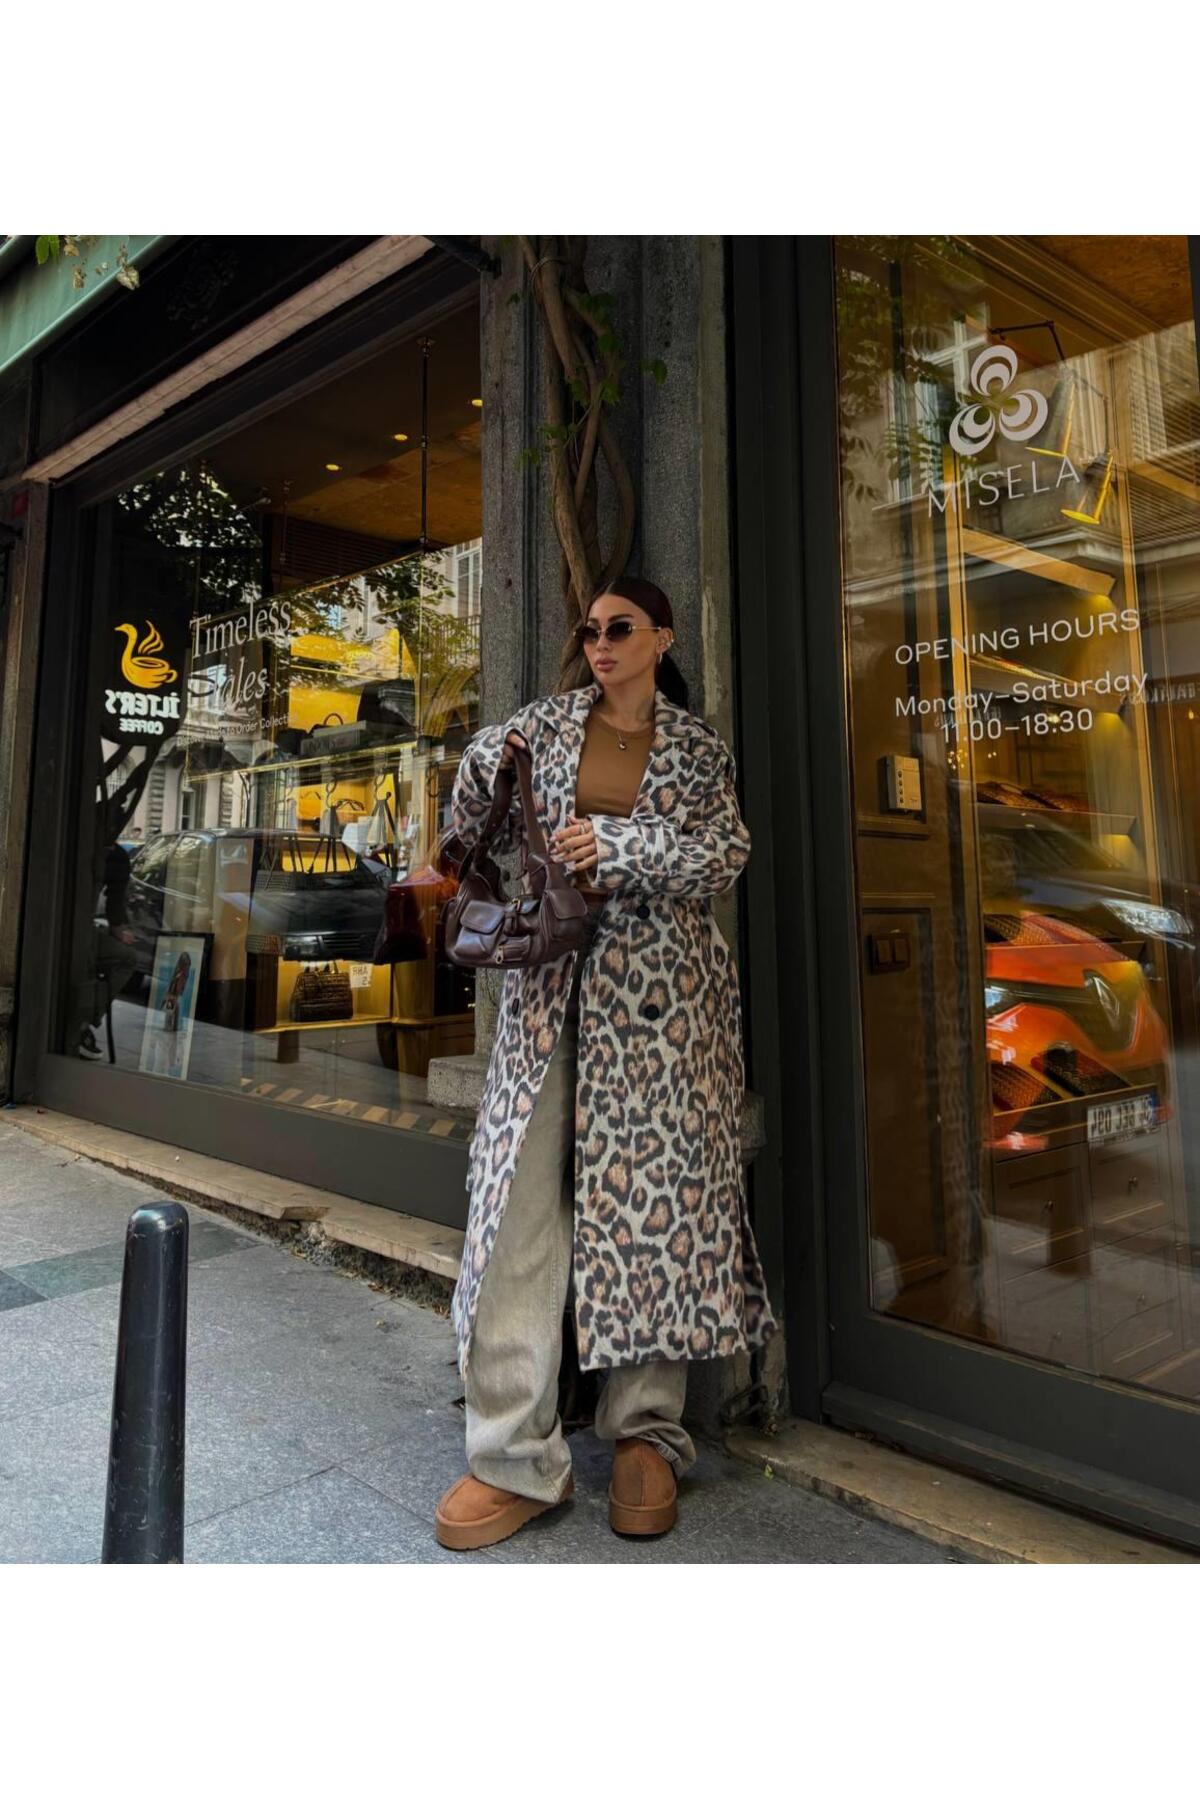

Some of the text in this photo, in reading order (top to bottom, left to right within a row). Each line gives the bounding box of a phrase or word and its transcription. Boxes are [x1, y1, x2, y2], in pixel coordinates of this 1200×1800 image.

[928, 455, 1081, 518] MISELA
[189, 600, 292, 658] Timeless
[895, 608, 1140, 665] OPENING HOURS
[236, 720, 258, 735] Order
